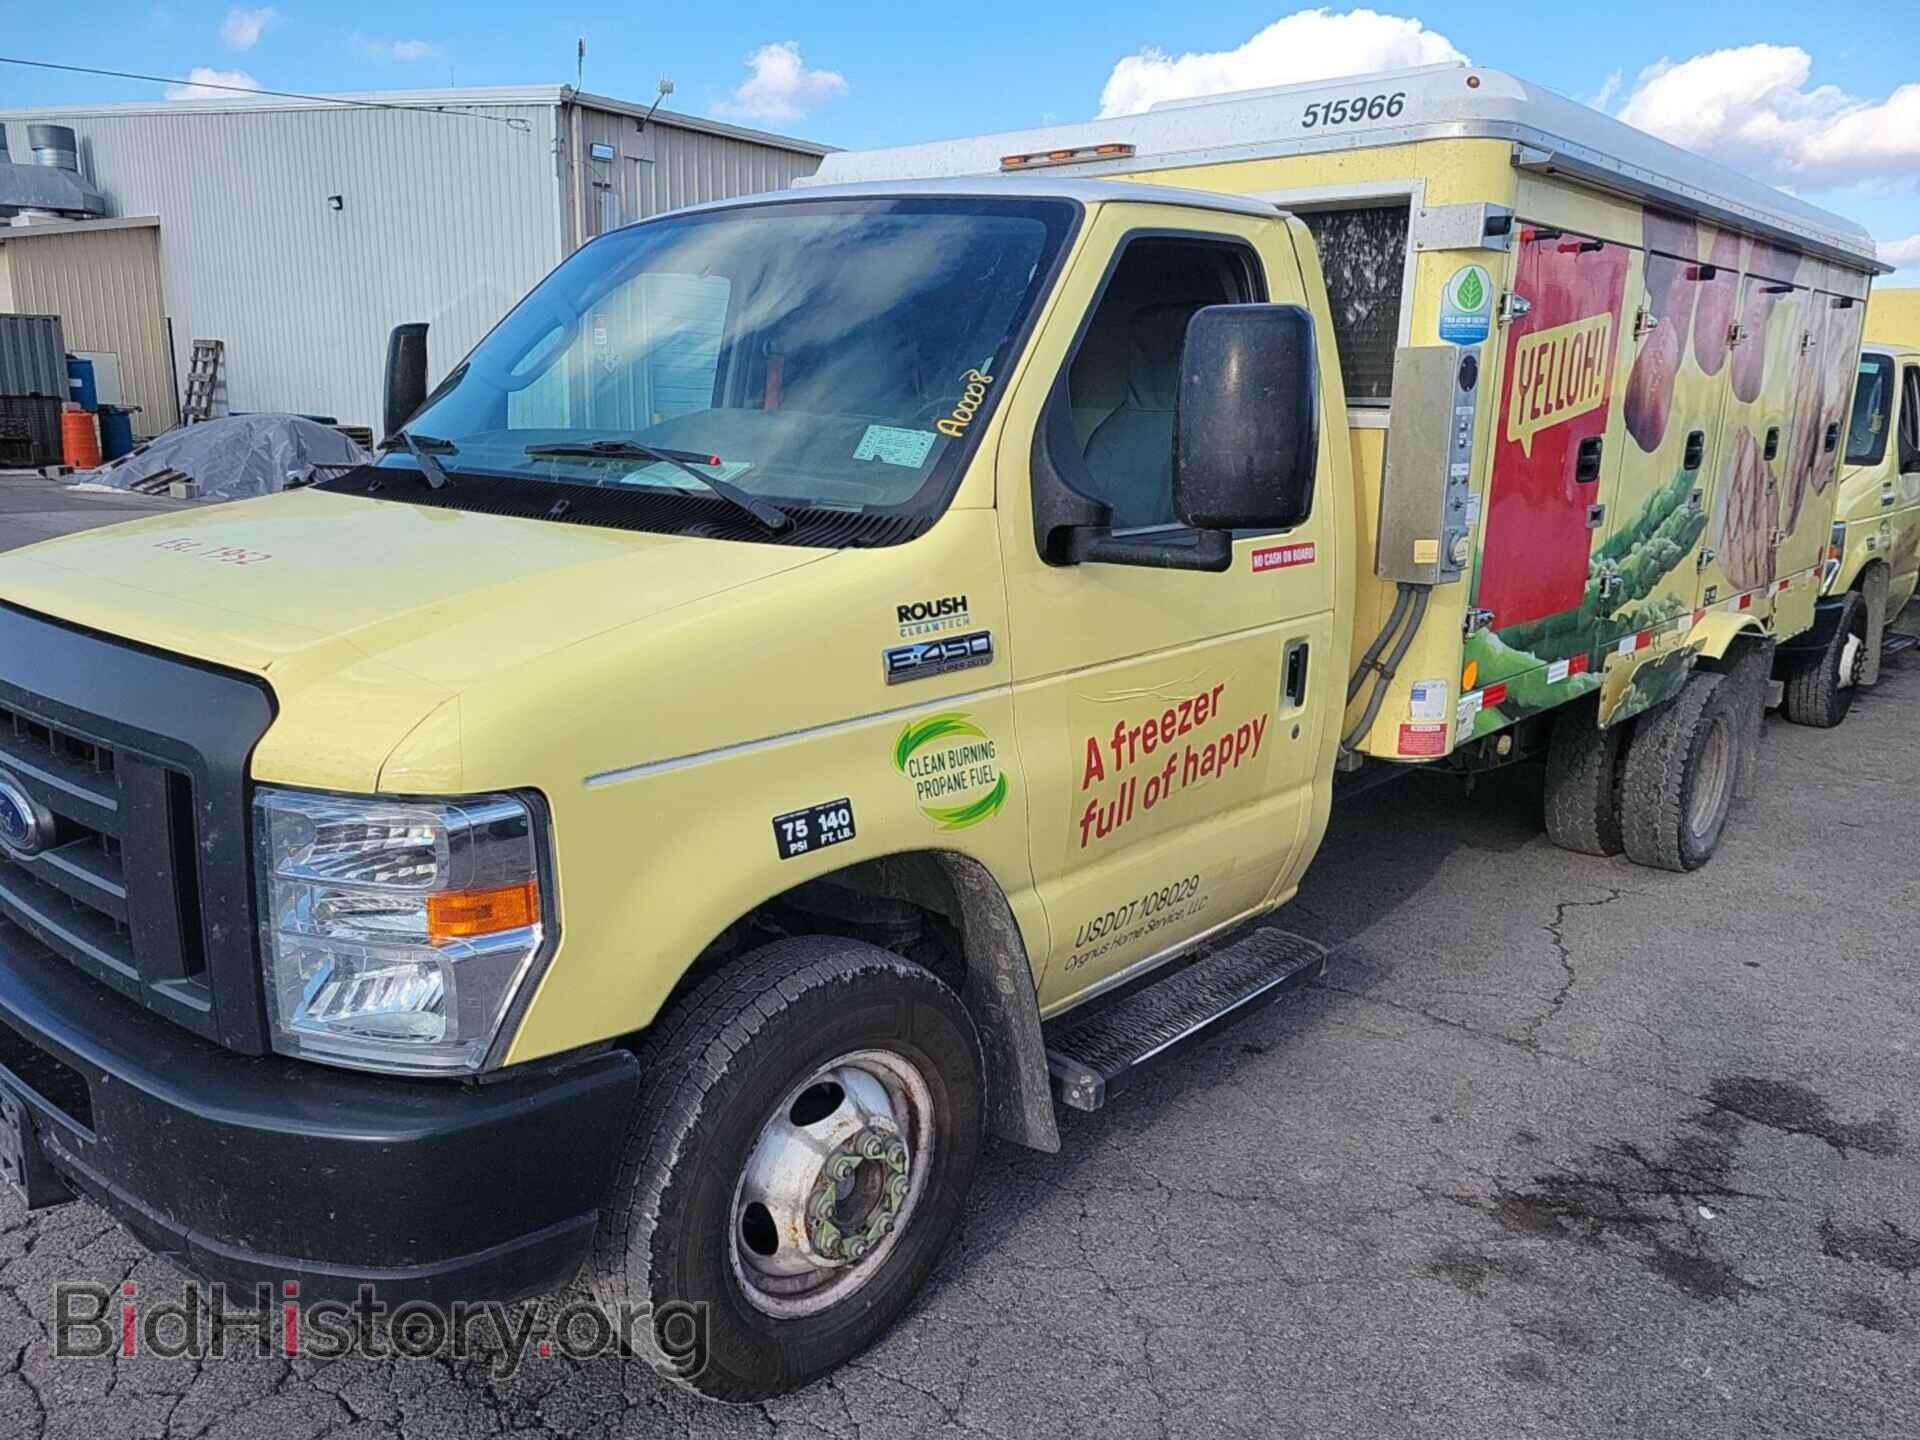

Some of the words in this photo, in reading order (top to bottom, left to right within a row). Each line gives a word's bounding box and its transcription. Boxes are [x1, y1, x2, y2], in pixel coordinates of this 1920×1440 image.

[1302, 92, 1406, 128] 515966
[1517, 325, 1607, 426] YELLOH!
[1253, 553, 1264, 568] NO
[1264, 551, 1282, 566] CASH
[896, 595, 968, 623] ROUSH
[900, 616, 971, 638] CLEANTECH
[1082, 736, 1105, 791] A
[1110, 683, 1225, 772] freezer
[908, 752, 946, 779] CLEAN
[949, 740, 996, 769] BURNING
[916, 772, 968, 801] PROPANE
[969, 766, 997, 789] FUEL
[1080, 776, 1137, 849] full
[1143, 752, 1178, 810] of
[1182, 713, 1268, 788] happy
[781, 818, 809, 842] 75
[818, 808, 851, 832] 140
[789, 840, 808, 855] PSI
[820, 831, 836, 845] FT.
[837, 827, 854, 840] LB.
[1075, 900, 1139, 948] USDOT
[1139, 874, 1200, 920] 108029
[1186, 896, 1209, 917] LLC
